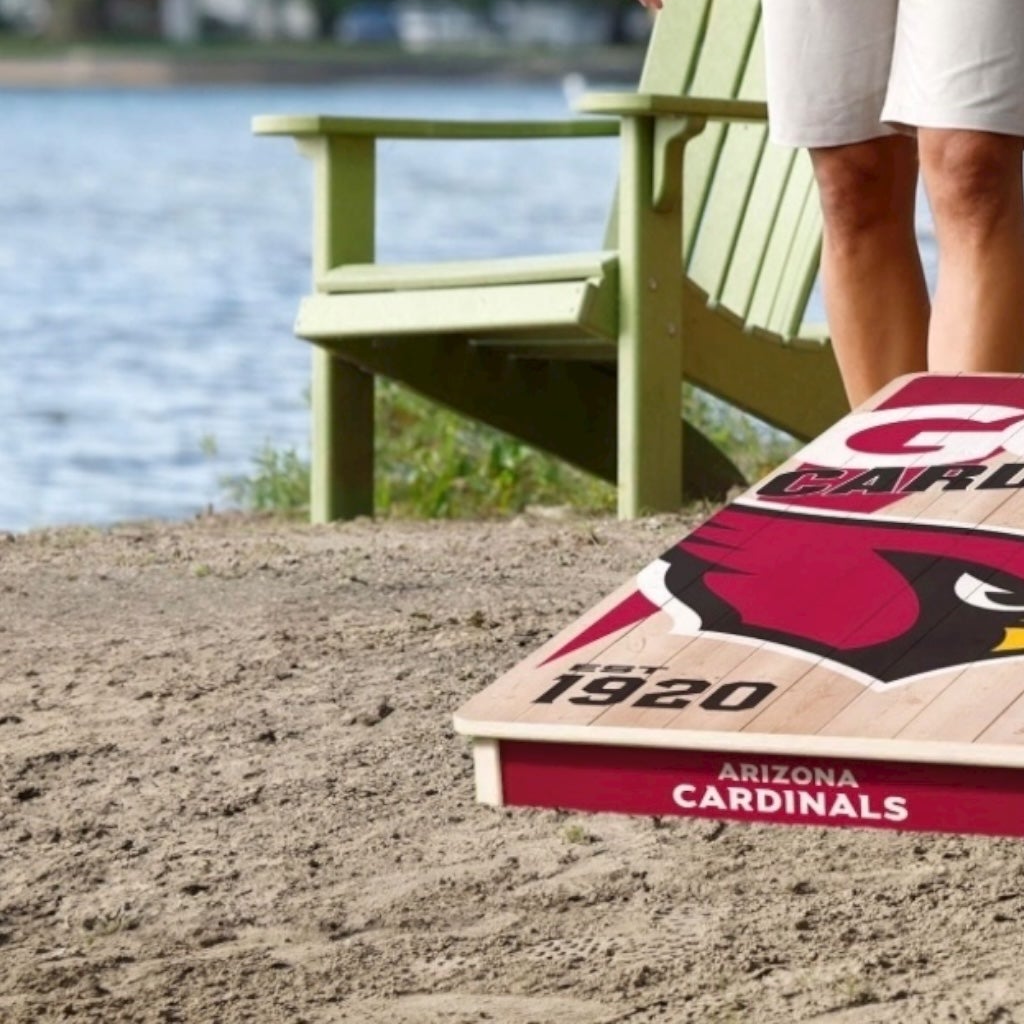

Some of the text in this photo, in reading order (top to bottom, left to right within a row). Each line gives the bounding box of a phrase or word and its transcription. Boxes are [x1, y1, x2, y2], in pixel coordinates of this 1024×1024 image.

[568, 663, 669, 675] EST
[531, 674, 778, 711] 1920
[717, 762, 860, 788] ARIZONA
[672, 784, 909, 822] CARDINALS
